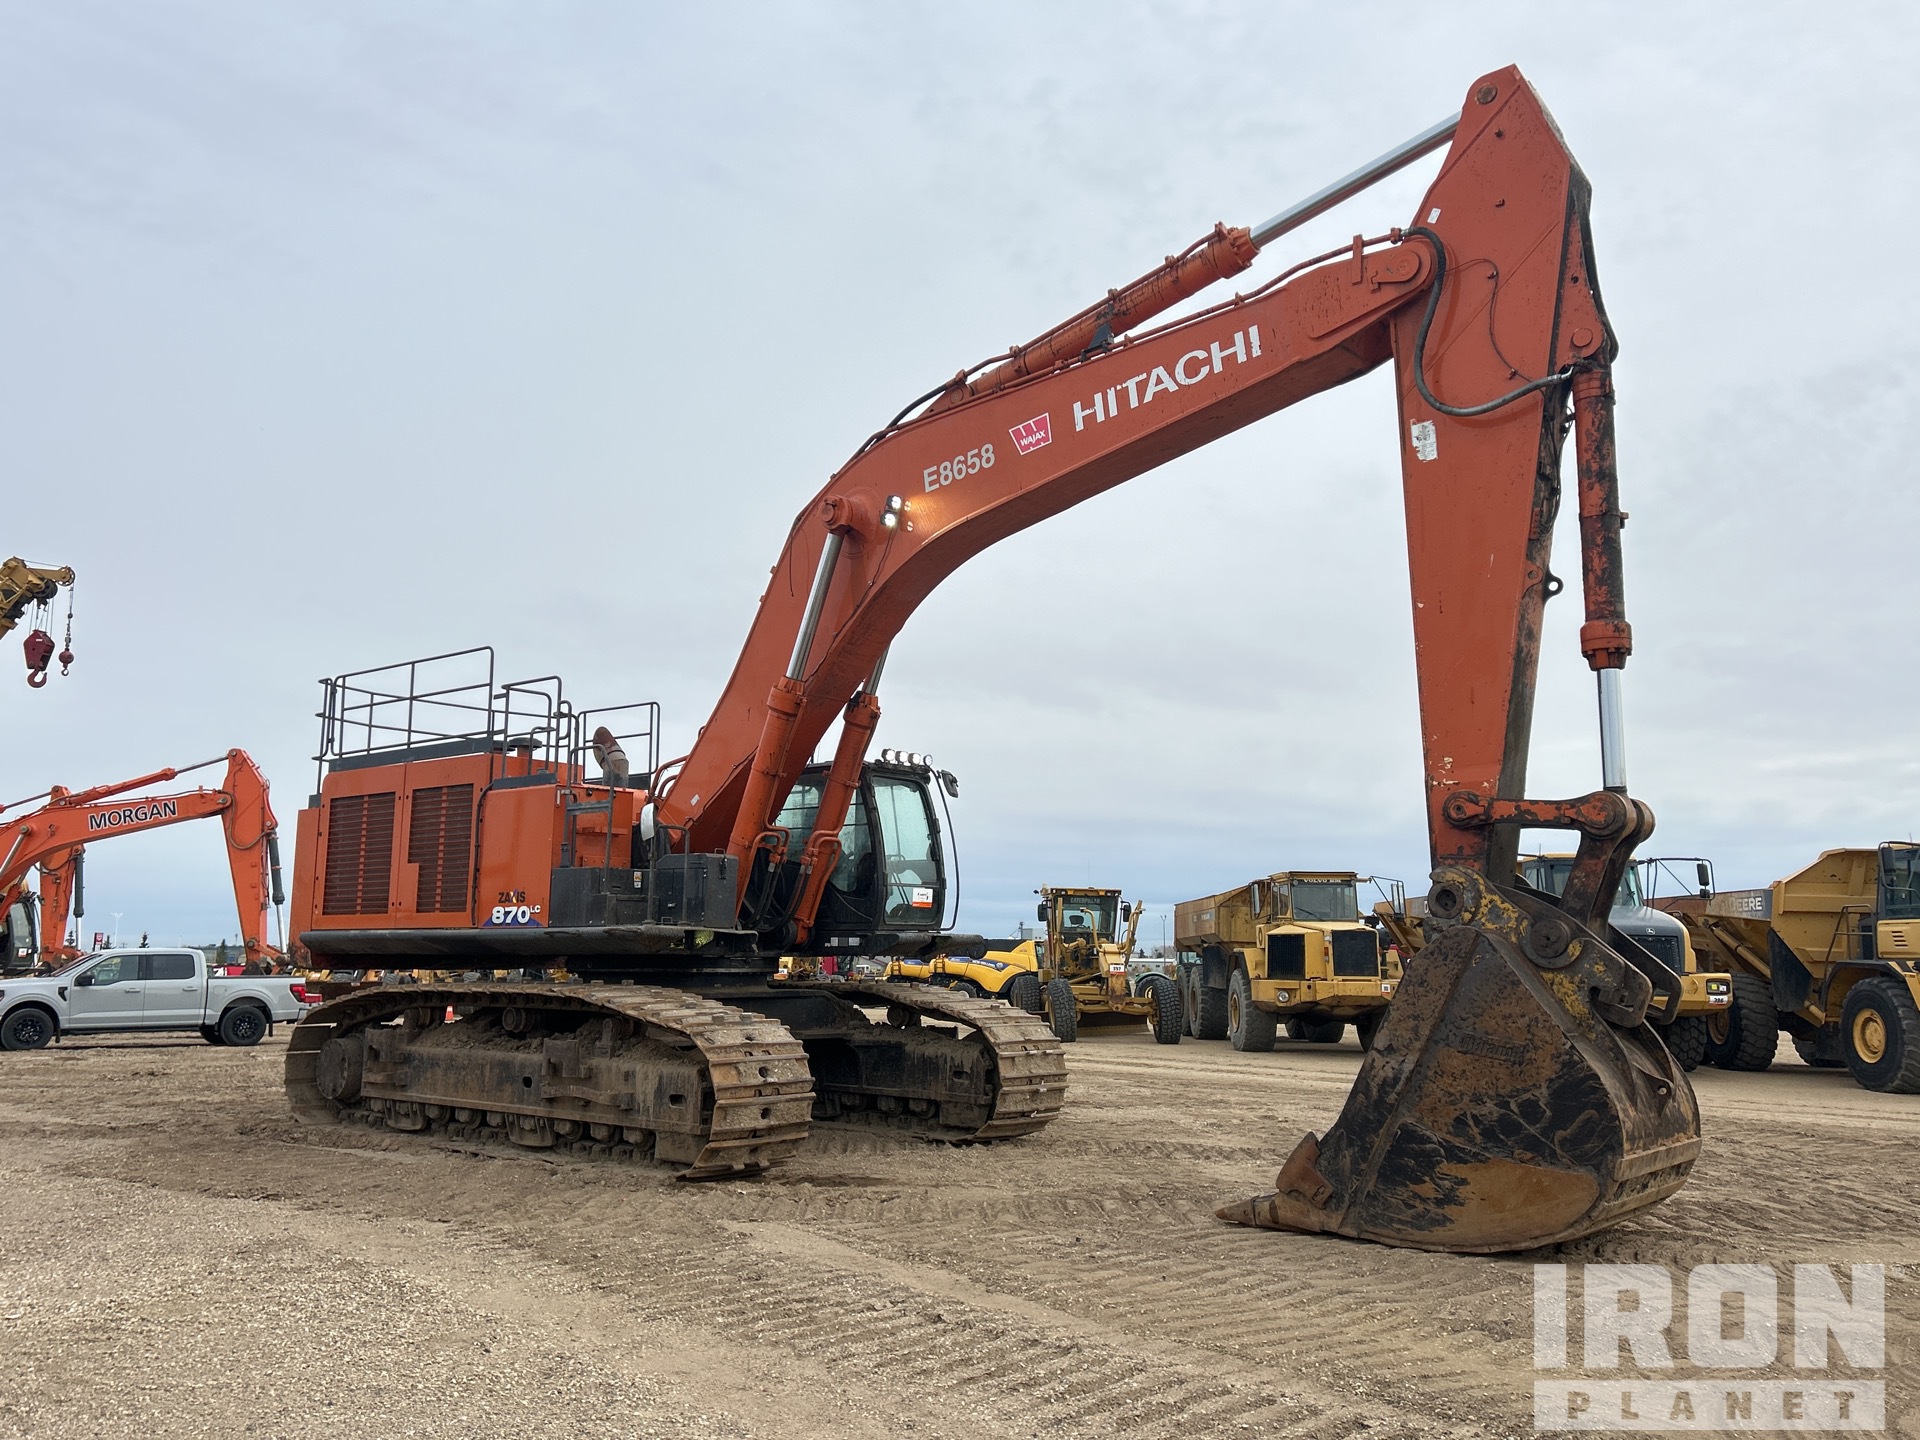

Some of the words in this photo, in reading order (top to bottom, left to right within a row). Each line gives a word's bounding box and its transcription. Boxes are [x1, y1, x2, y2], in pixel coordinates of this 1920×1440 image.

[1073, 325, 1262, 432] HITACHI
[1020, 430, 1046, 447] WAJAX
[923, 443, 995, 493] E8658
[88, 800, 178, 831] MORGAN
